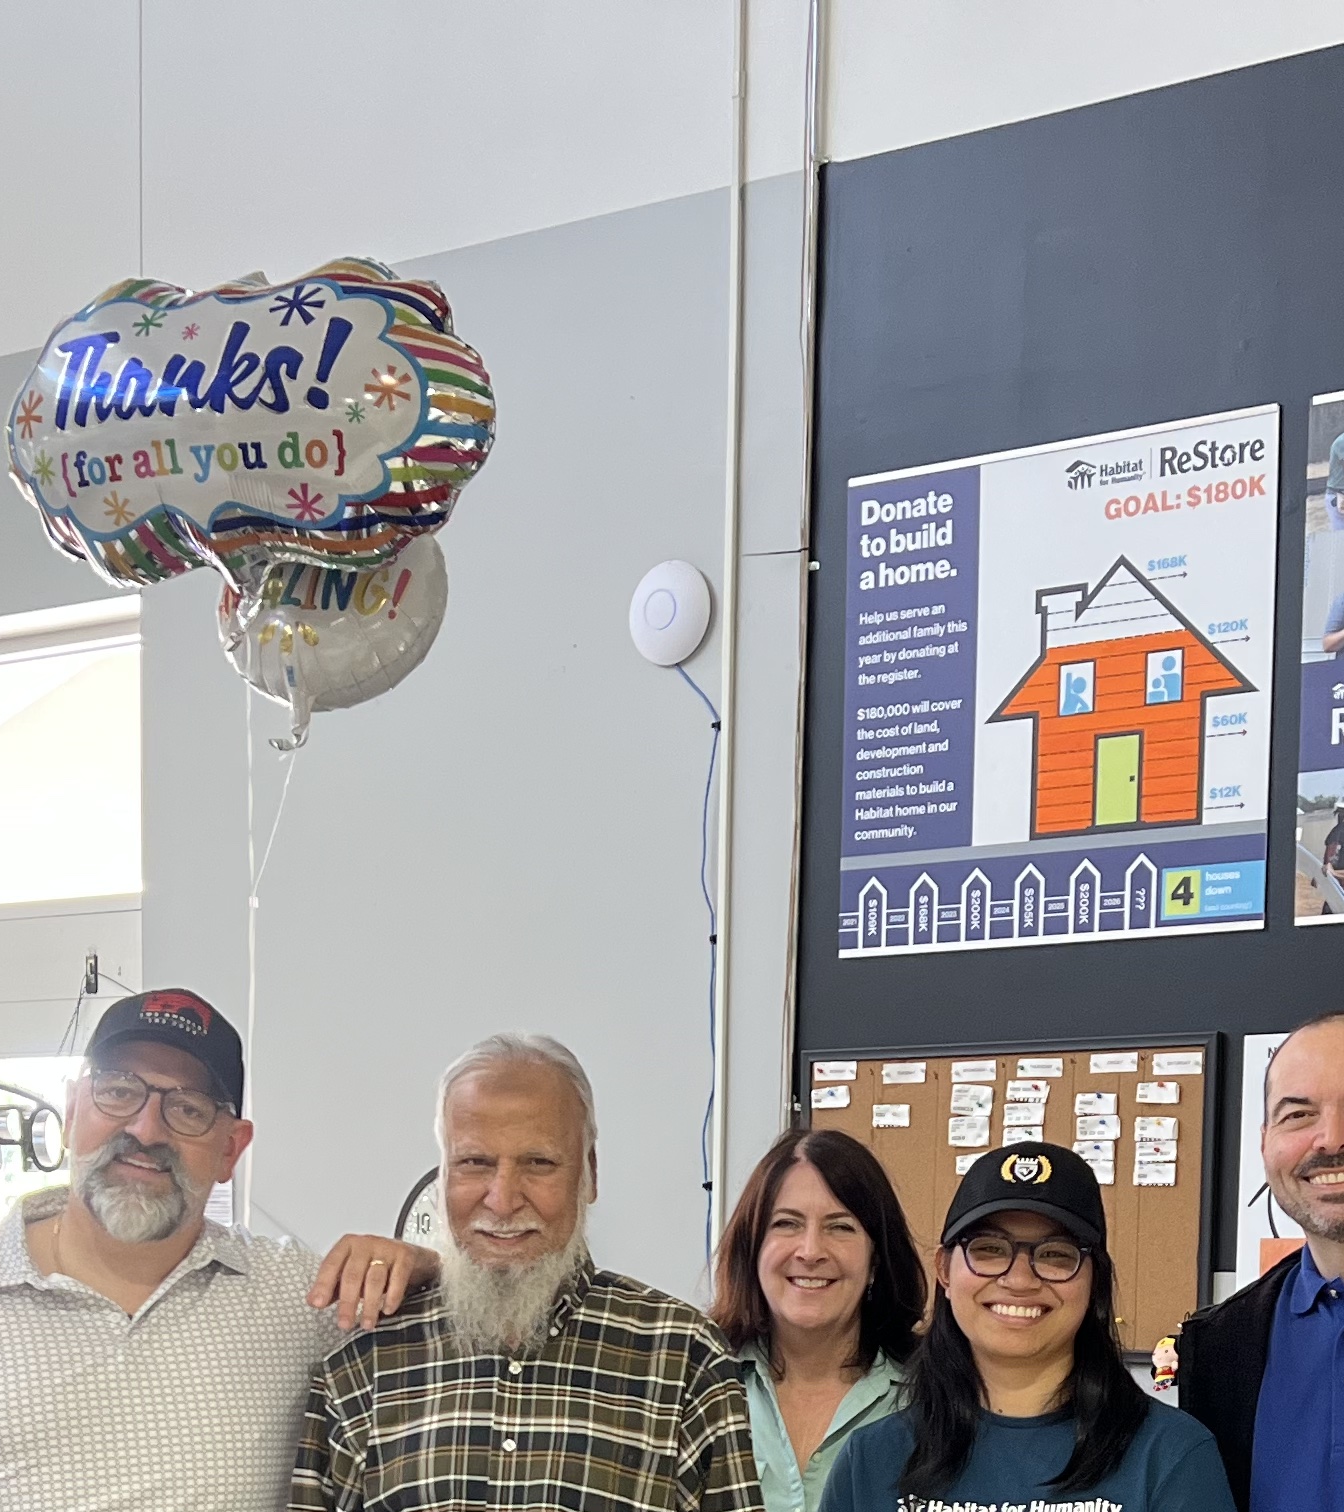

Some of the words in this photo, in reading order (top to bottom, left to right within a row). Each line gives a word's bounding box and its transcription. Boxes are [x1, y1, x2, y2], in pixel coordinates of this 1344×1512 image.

[55, 317, 354, 430] Thanks!
[133, 438, 183, 479] all
[190, 441, 268, 483] you
[1100, 459, 1144, 477] Habitat
[1159, 439, 1265, 477] ReStore
[1111, 474, 1144, 485] Humanity
[1105, 490, 1181, 520] GOAL:
[1186, 474, 1266, 509] $180K
[861, 491, 953, 526] Donate
[860, 534, 886, 558] to
[890, 519, 953, 553] build
[1147, 554, 1187, 572] $168K
[860, 570, 875, 590] a
[879, 559, 957, 588] home.
[859, 611, 884, 625] Help
[885, 611, 898, 621] us
[900, 606, 930, 620] serve
[931, 604, 945, 615] an
[859, 627, 911, 645] additional
[913, 623, 946, 637] family
[947, 620, 968, 633] this
[1207, 618, 1248, 635] $120K
[858, 653, 882, 668] year
[883, 650, 897, 663] by
[898, 644, 946, 660] donating
[948, 641, 959, 654] at
[858, 674, 876, 685] the
[877, 668, 922, 684] register.
[857, 703, 910, 721] $180,000
[911, 700, 930, 713] will
[931, 699, 962, 712] cover
[1212, 712, 1248, 728] $60K
[857, 728, 874, 740] the
[876, 725, 899, 738] cost
[901, 722, 913, 735] of
[914, 720, 940, 734] land,
[856, 741, 927, 760] development
[928, 739, 949, 753] and
[856, 763, 924, 780] construction
[855, 785, 904, 800] materials
[906, 784, 918, 795] to
[919, 780, 945, 794] build
[947, 781, 955, 792] a
[1209, 784, 1242, 800] $12K
[855, 806, 894, 820] Habitat
[895, 803, 925, 817] home
[927, 802, 937, 814] in
[938, 801, 958, 812] our
[854, 824, 918, 841] community.
[1205, 871, 1241, 881] houses
[1171, 876, 1194, 906] 4
[1205, 886, 1232, 896] down
[918, 895, 930, 933] $168K
[970, 889, 982, 931] $200K
[1023, 887, 1035, 929] $205K
[1078, 882, 1090, 925] $200K
